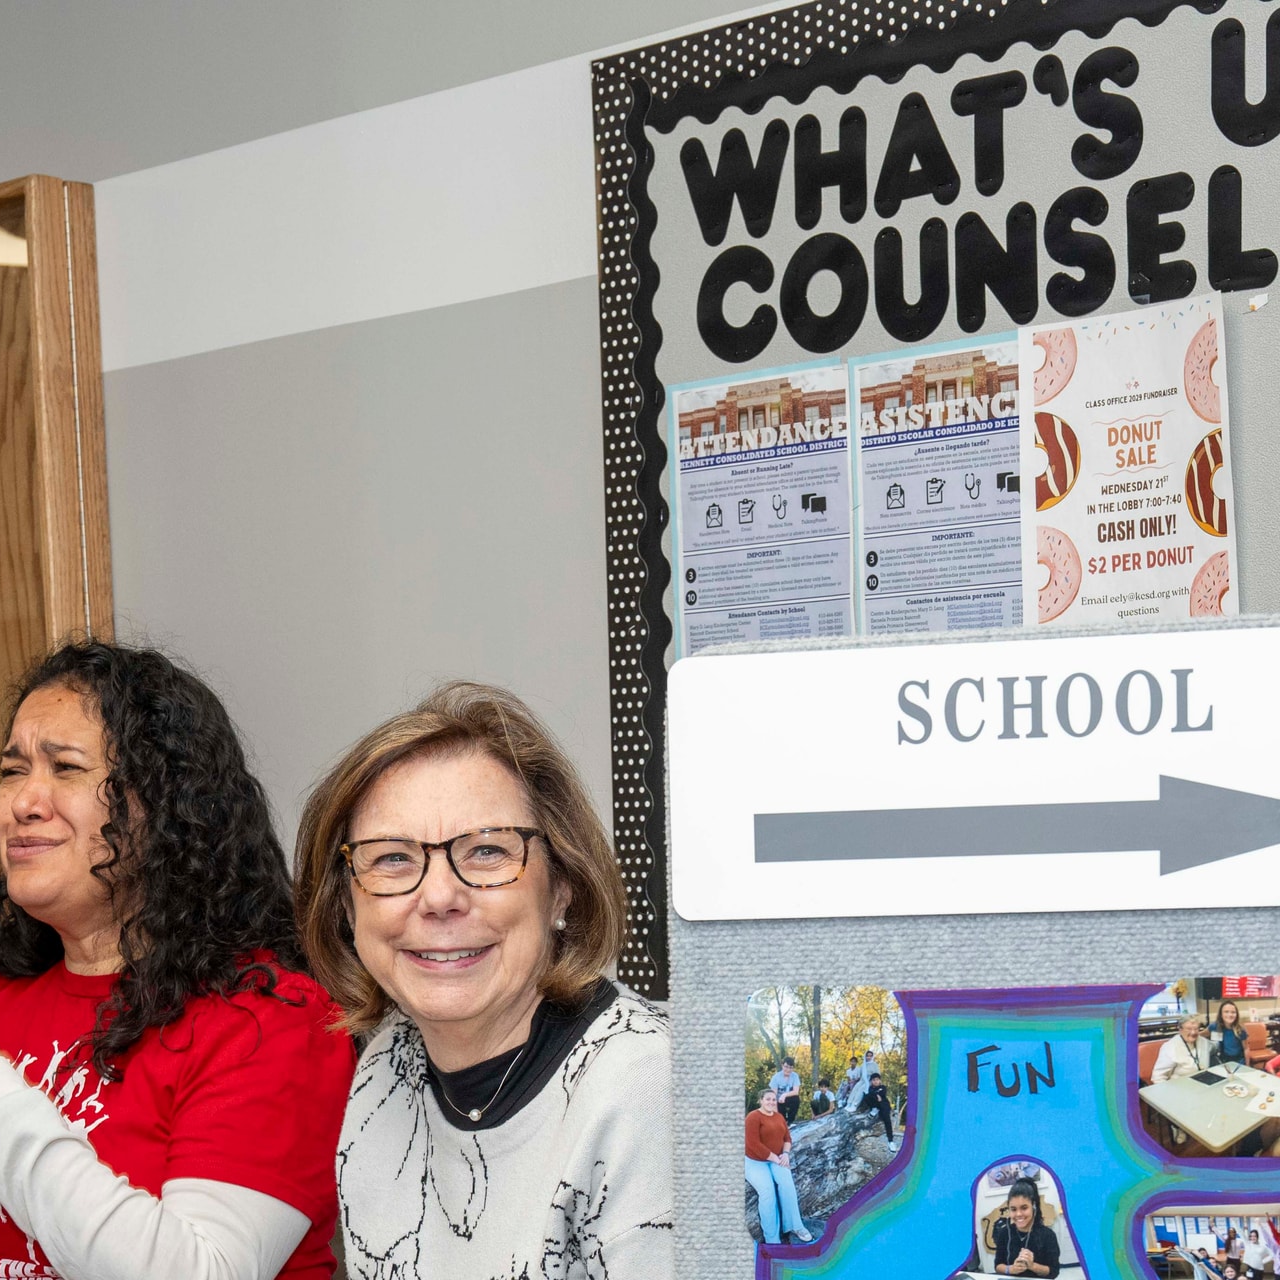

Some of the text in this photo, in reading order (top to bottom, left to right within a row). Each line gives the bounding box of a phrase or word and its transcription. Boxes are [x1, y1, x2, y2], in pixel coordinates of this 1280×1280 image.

[680, 46, 1143, 246] WHAT'S
[1085, 388, 1178, 409] CLASS OFFICE 2029 FUNDRAISER
[679, 416, 848, 458] ATTENDANCE
[862, 436, 896, 448] DISTRITO
[898, 431, 934, 442] ESCOLAR
[936, 423, 992, 436] CONSOLIDADO
[1108, 420, 1162, 446] DONUT
[680, 439, 848, 469] KENNETT CONSOLIDATED SCHOOL DISTRICT
[946, 442, 970, 452] llegando
[972, 439, 990, 447] tarde?
[1116, 444, 1156, 468] SALE
[779, 462, 794, 470] Late?
[1101, 480, 1153, 496] WEDNESDAY
[1087, 494, 1182, 515] IN THE LOBBY 7:00-7:40
[932, 532, 975, 542] IMPORTANTE:
[1098, 514, 1176, 543] CASH ONLY!
[746, 550, 782, 559] IMPORTANT:
[1088, 546, 1194, 575] $2 PER DONUT
[869, 578, 876, 587] 10
[688, 594, 696, 602] 10
[943, 594, 970, 602] asistencia
[972, 594, 982, 602] por
[1081, 586, 1190, 606] Email eely@kcsd.org with
[728, 606, 806, 620] Attendance Contacts by School
[1117, 604, 1159, 619] questions
[897, 667, 1214, 746] SCHOOL
[966, 1042, 1056, 1098] FUN
